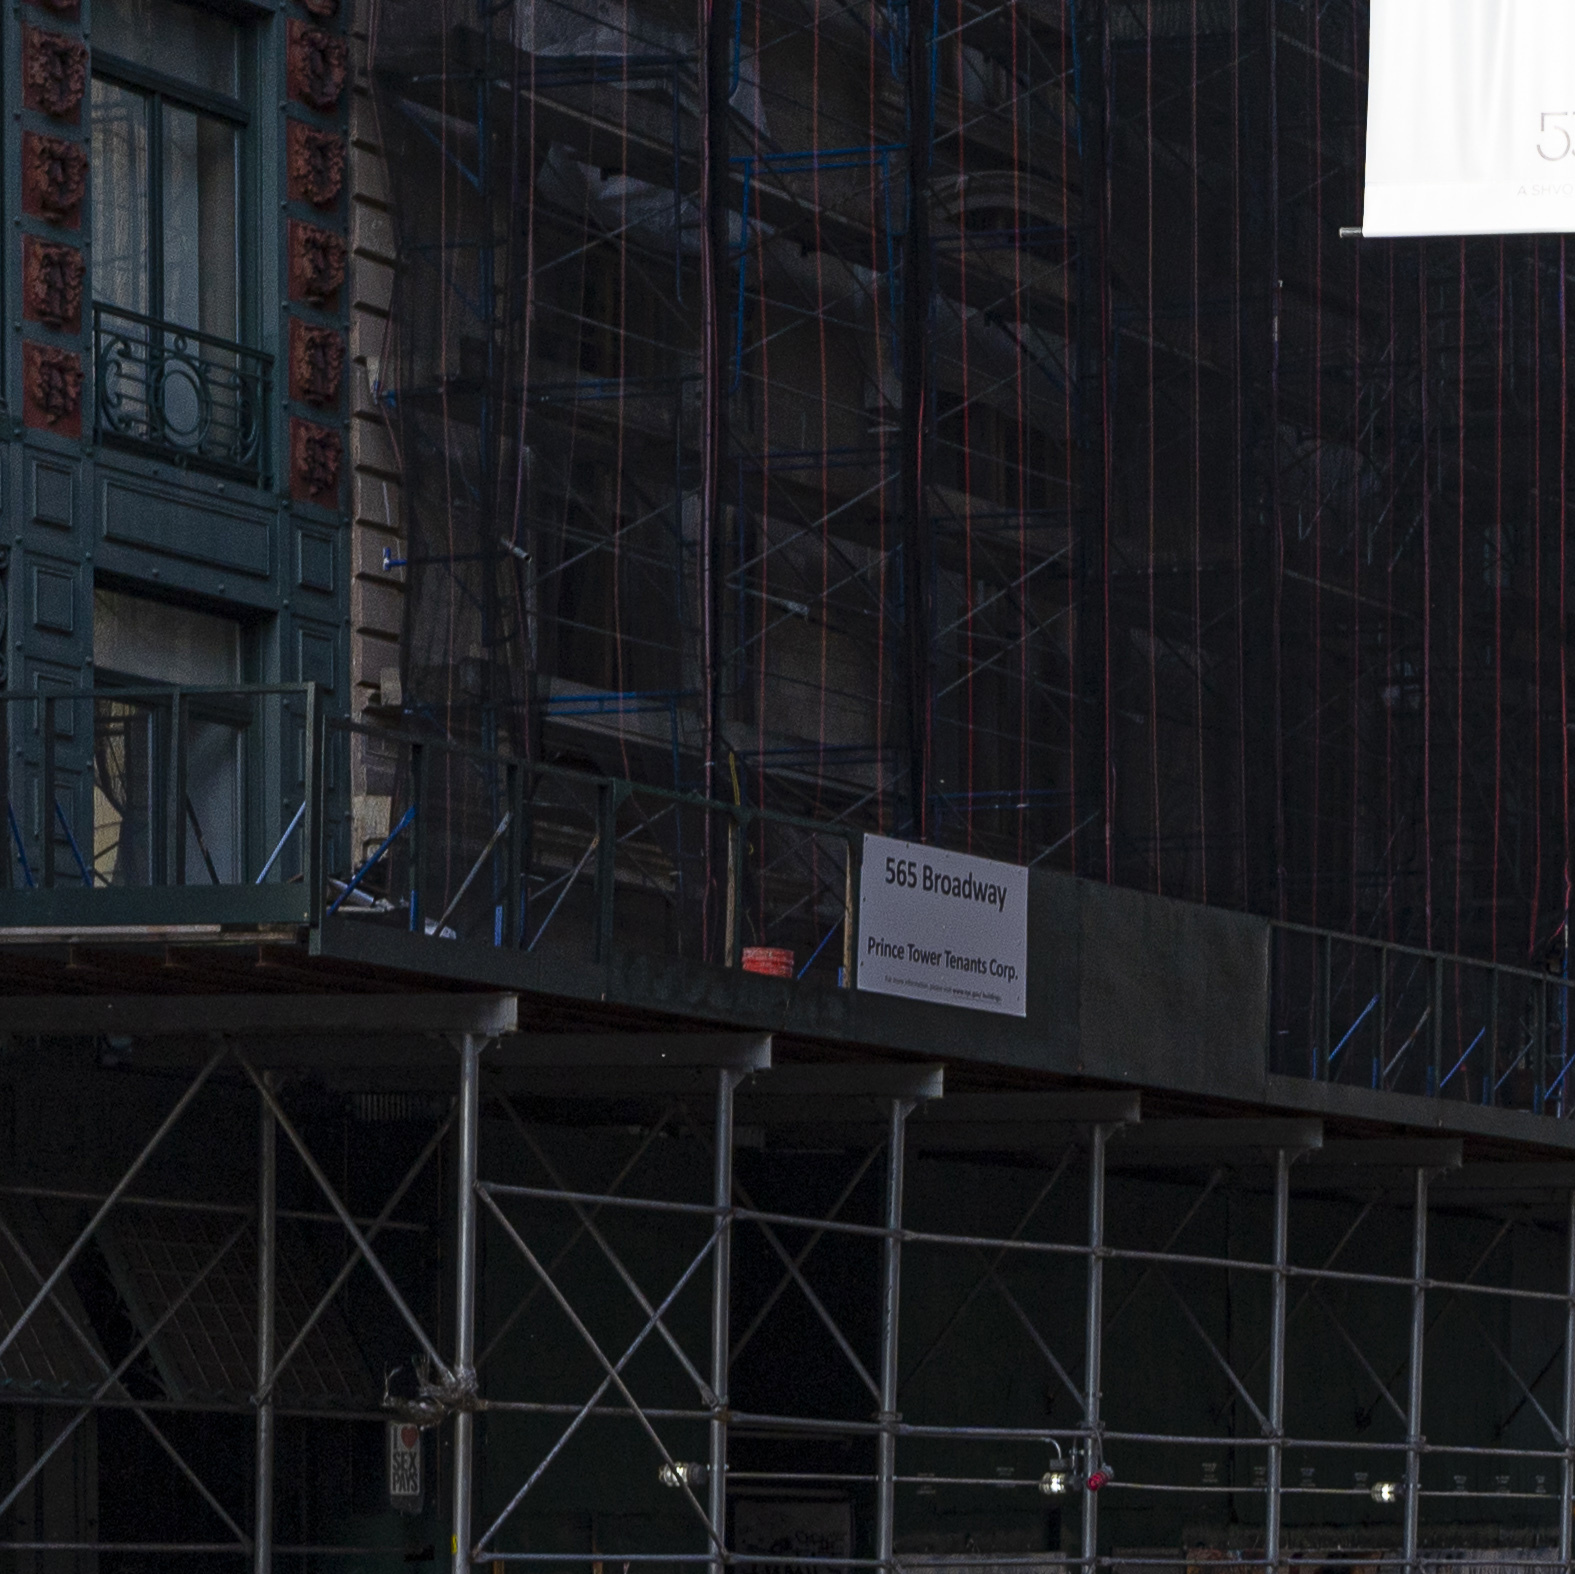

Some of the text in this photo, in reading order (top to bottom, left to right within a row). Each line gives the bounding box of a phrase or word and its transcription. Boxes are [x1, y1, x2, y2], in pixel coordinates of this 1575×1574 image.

[1517, 185, 1527, 196] A
[886, 856, 1008, 912] 565 Broadway
[867, 935, 1019, 983] Prince Tower Tenants Corp.
[393, 1451, 419, 1472] SEX
[391, 1471, 419, 1493] PAYS
